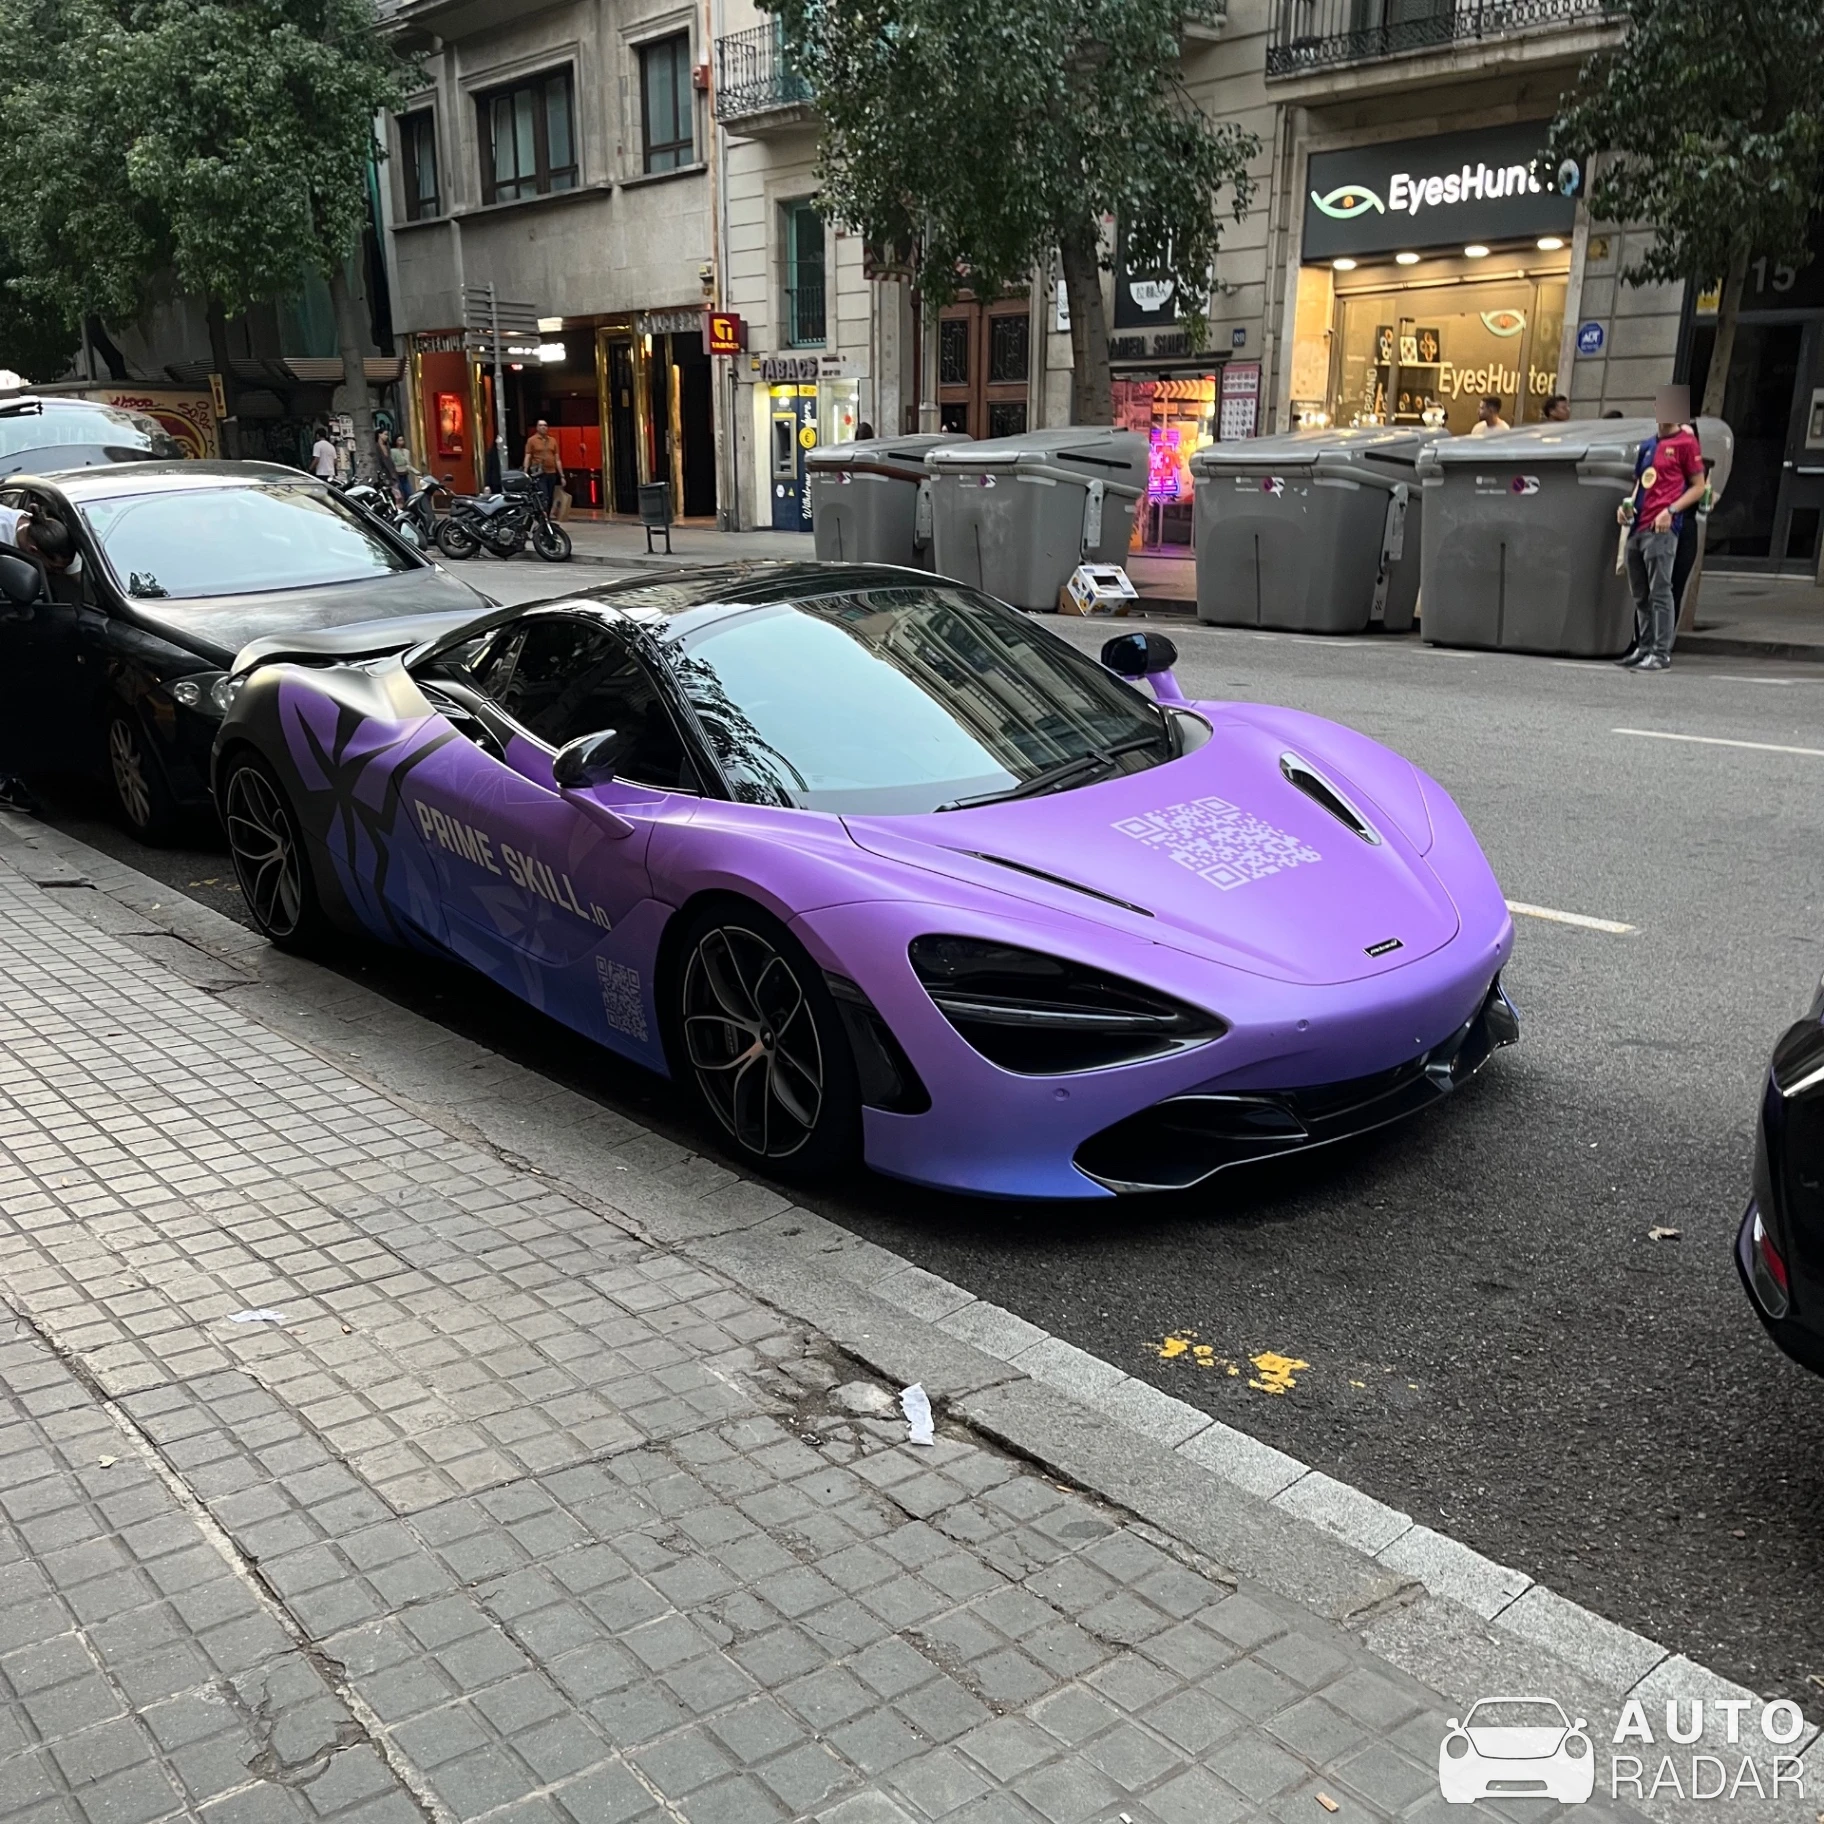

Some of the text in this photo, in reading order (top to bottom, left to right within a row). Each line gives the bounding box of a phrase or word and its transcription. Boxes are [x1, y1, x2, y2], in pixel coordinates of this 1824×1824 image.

[1751, 256, 1797, 294] 15
[760, 356, 819, 380] TABACS
[802, 472, 813, 521] Withdraw
[414, 798, 503, 876] PRIME
